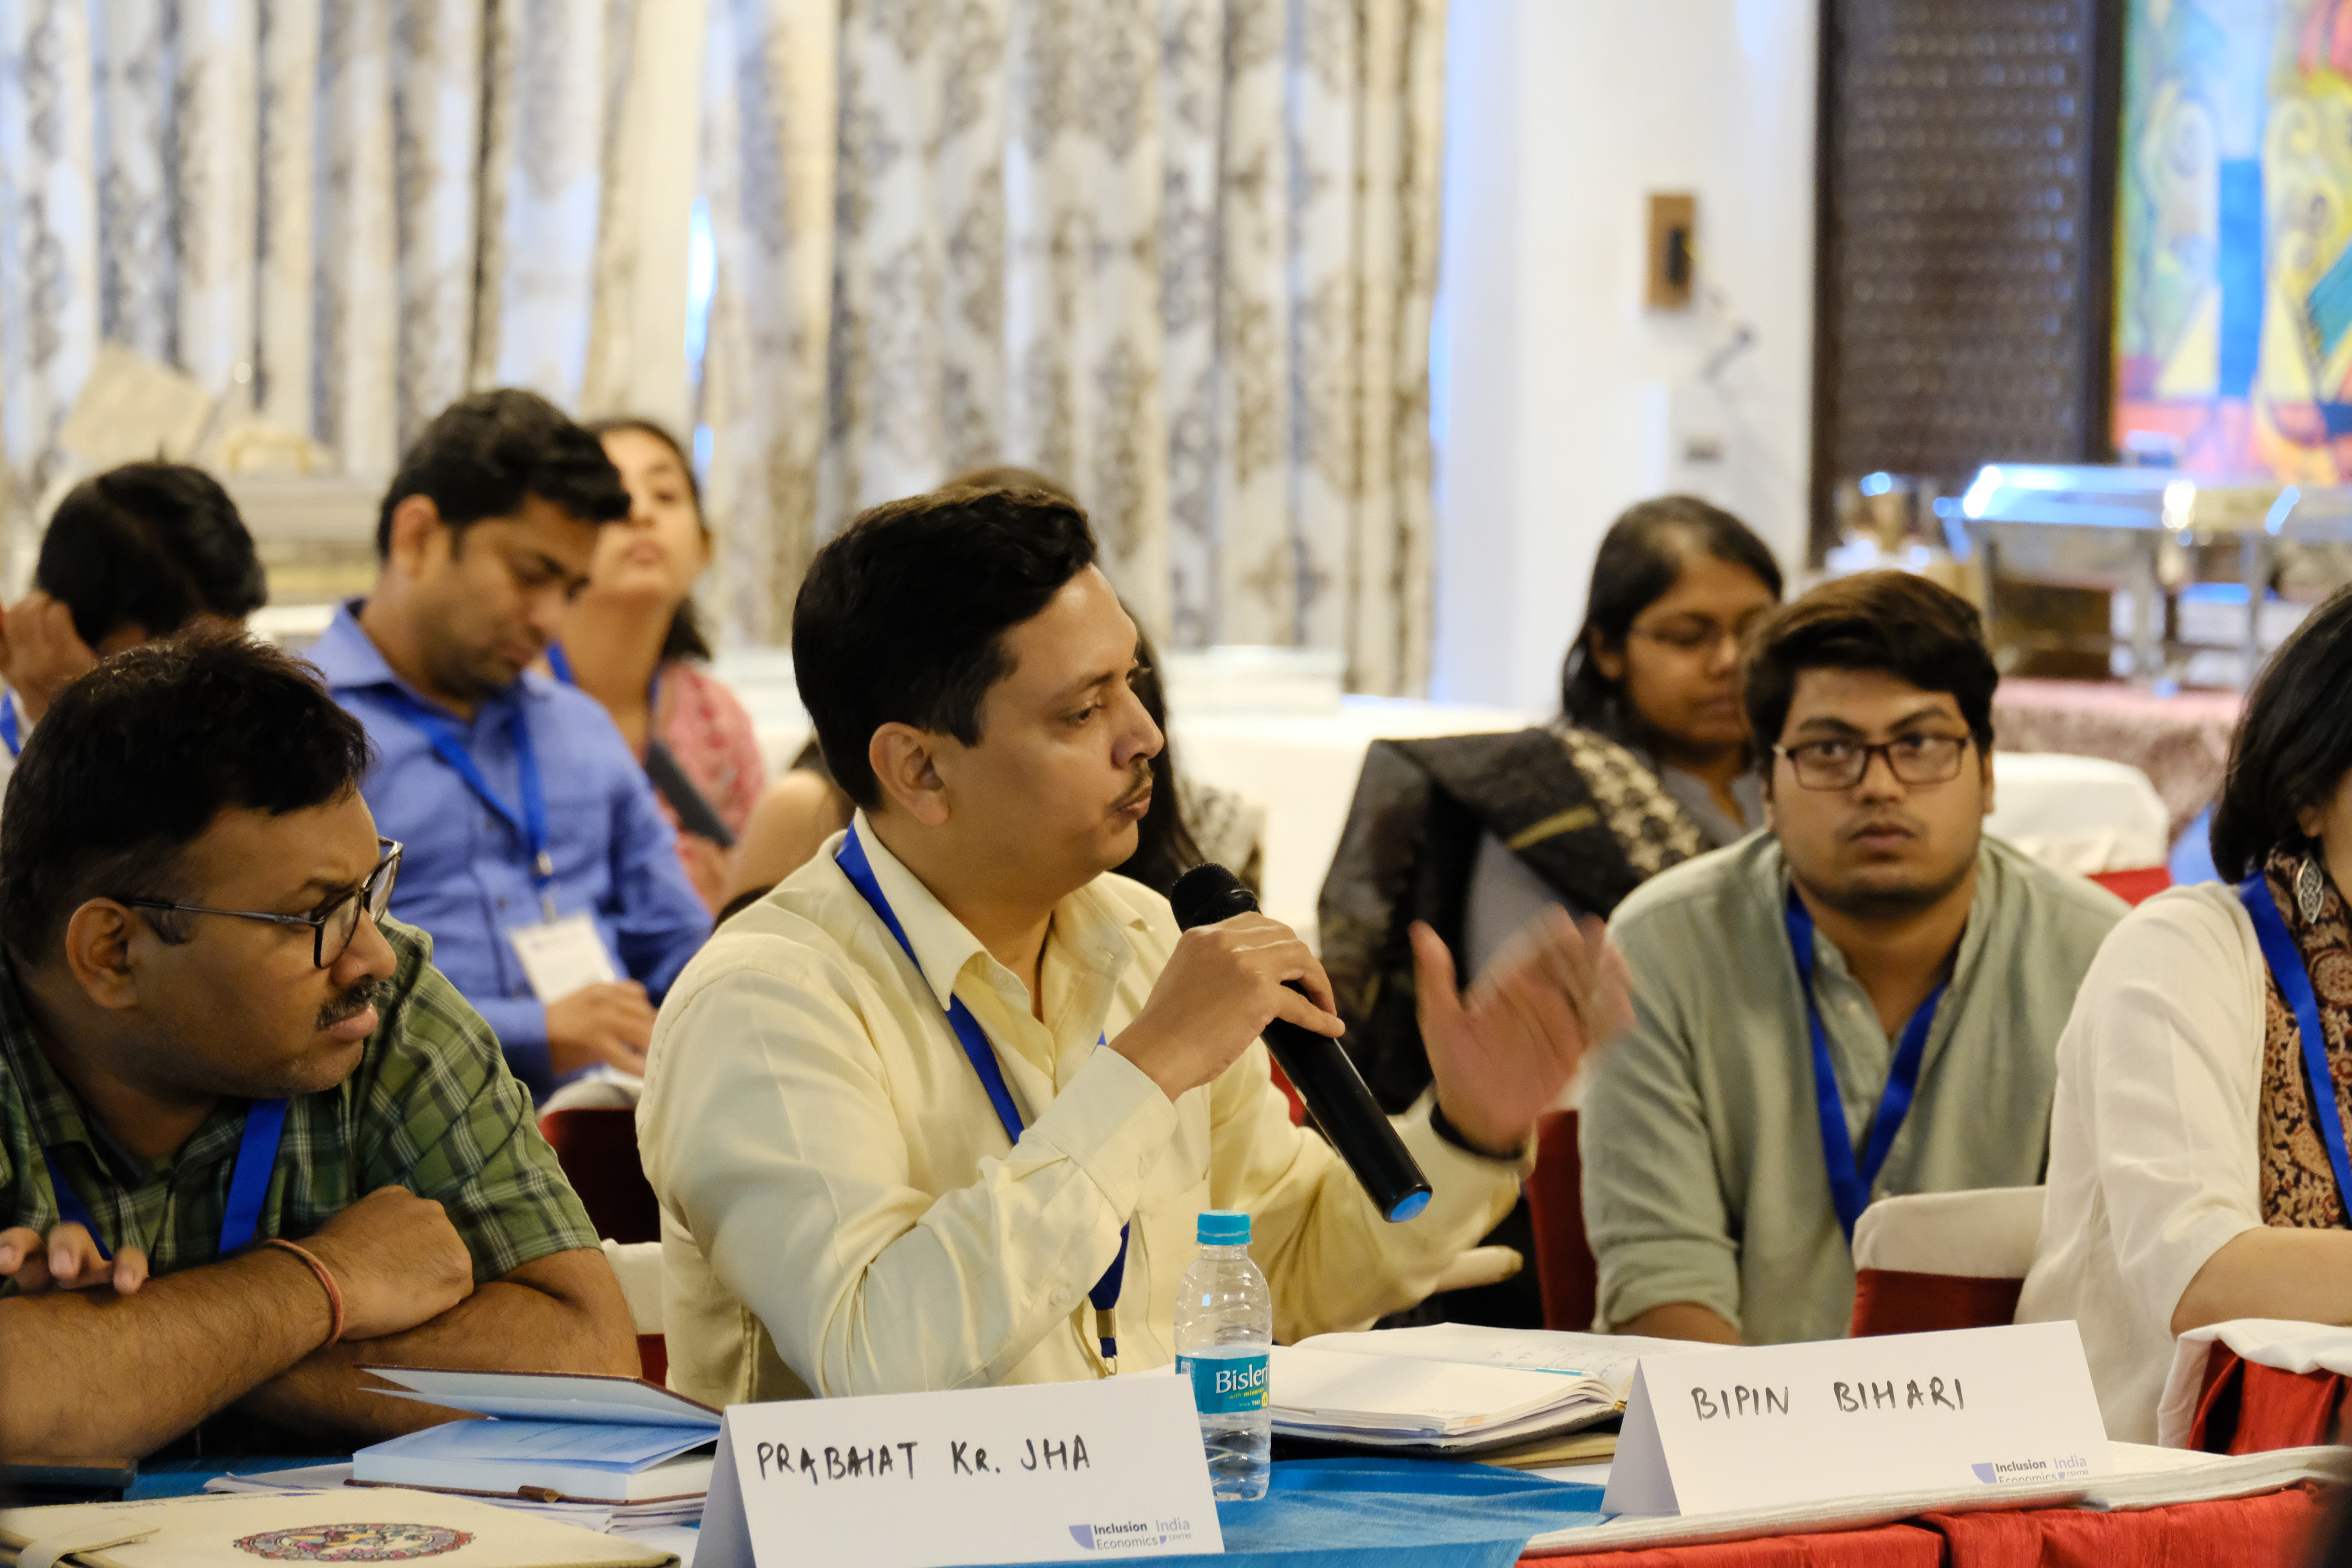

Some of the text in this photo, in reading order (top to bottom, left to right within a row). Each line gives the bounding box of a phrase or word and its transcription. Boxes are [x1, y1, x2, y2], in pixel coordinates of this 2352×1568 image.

[1216, 1361, 1268, 1394] Bisleri
[1244, 1387, 1264, 1397] minerals
[1691, 1376, 1964, 1421] BIPIN BIHARI
[757, 1441, 918, 1485] PRABAHAT
[1020, 1434, 1090, 1471] JHA
[1995, 1454, 2087, 1473] Inclusion India
[1094, 1517, 1190, 1535] Inclusion India
[1096, 1535, 1158, 1550] Economics
